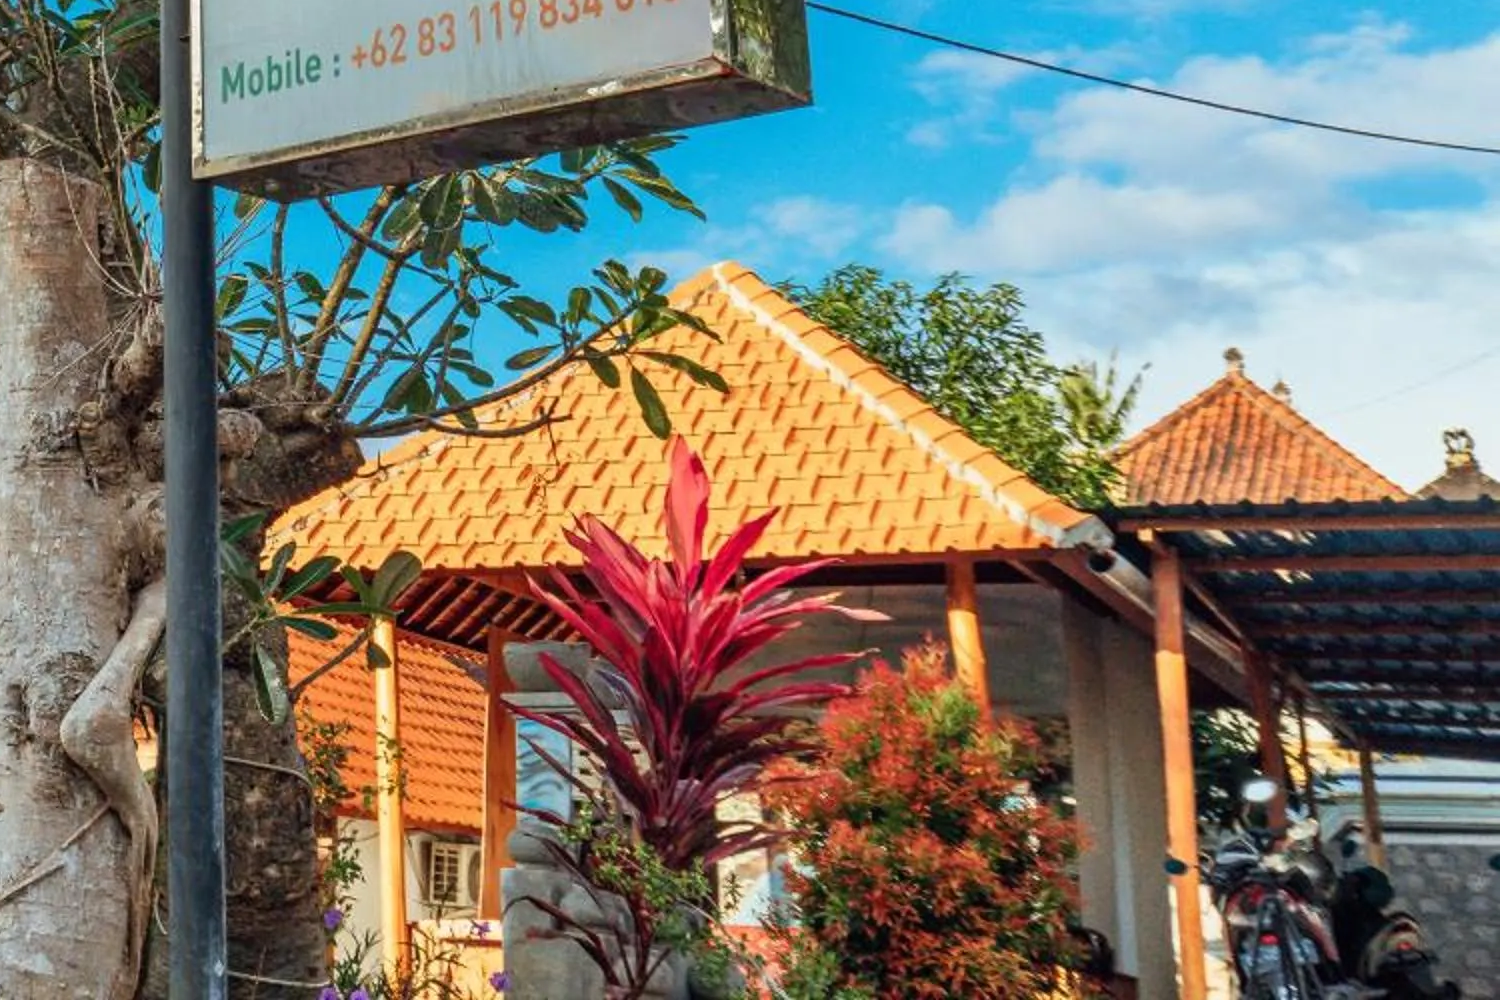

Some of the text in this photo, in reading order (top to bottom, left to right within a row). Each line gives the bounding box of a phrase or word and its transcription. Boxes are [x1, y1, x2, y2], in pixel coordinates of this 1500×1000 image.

[221, 48, 322, 104] Mobile
[350, 23, 407, 71] +62
[417, 12, 456, 56] 83
